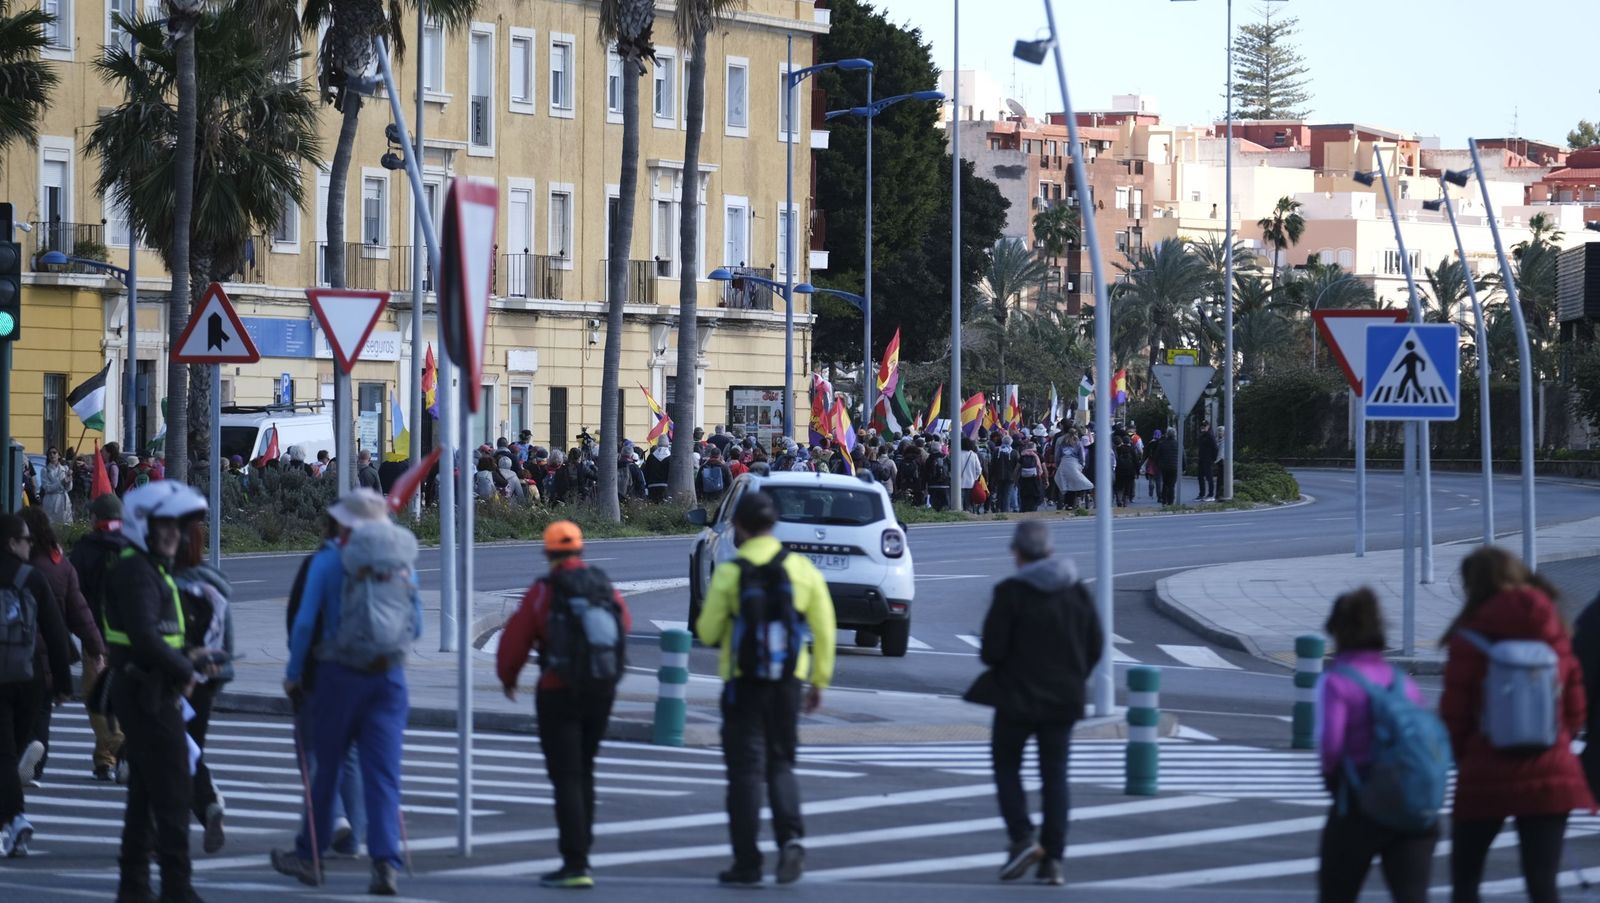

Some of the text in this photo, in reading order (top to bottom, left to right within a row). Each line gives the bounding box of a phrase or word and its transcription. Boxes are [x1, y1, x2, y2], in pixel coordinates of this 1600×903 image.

[366, 339, 394, 358] seguros
[283, 374, 290, 392] P
[826, 555, 847, 566] LRY
